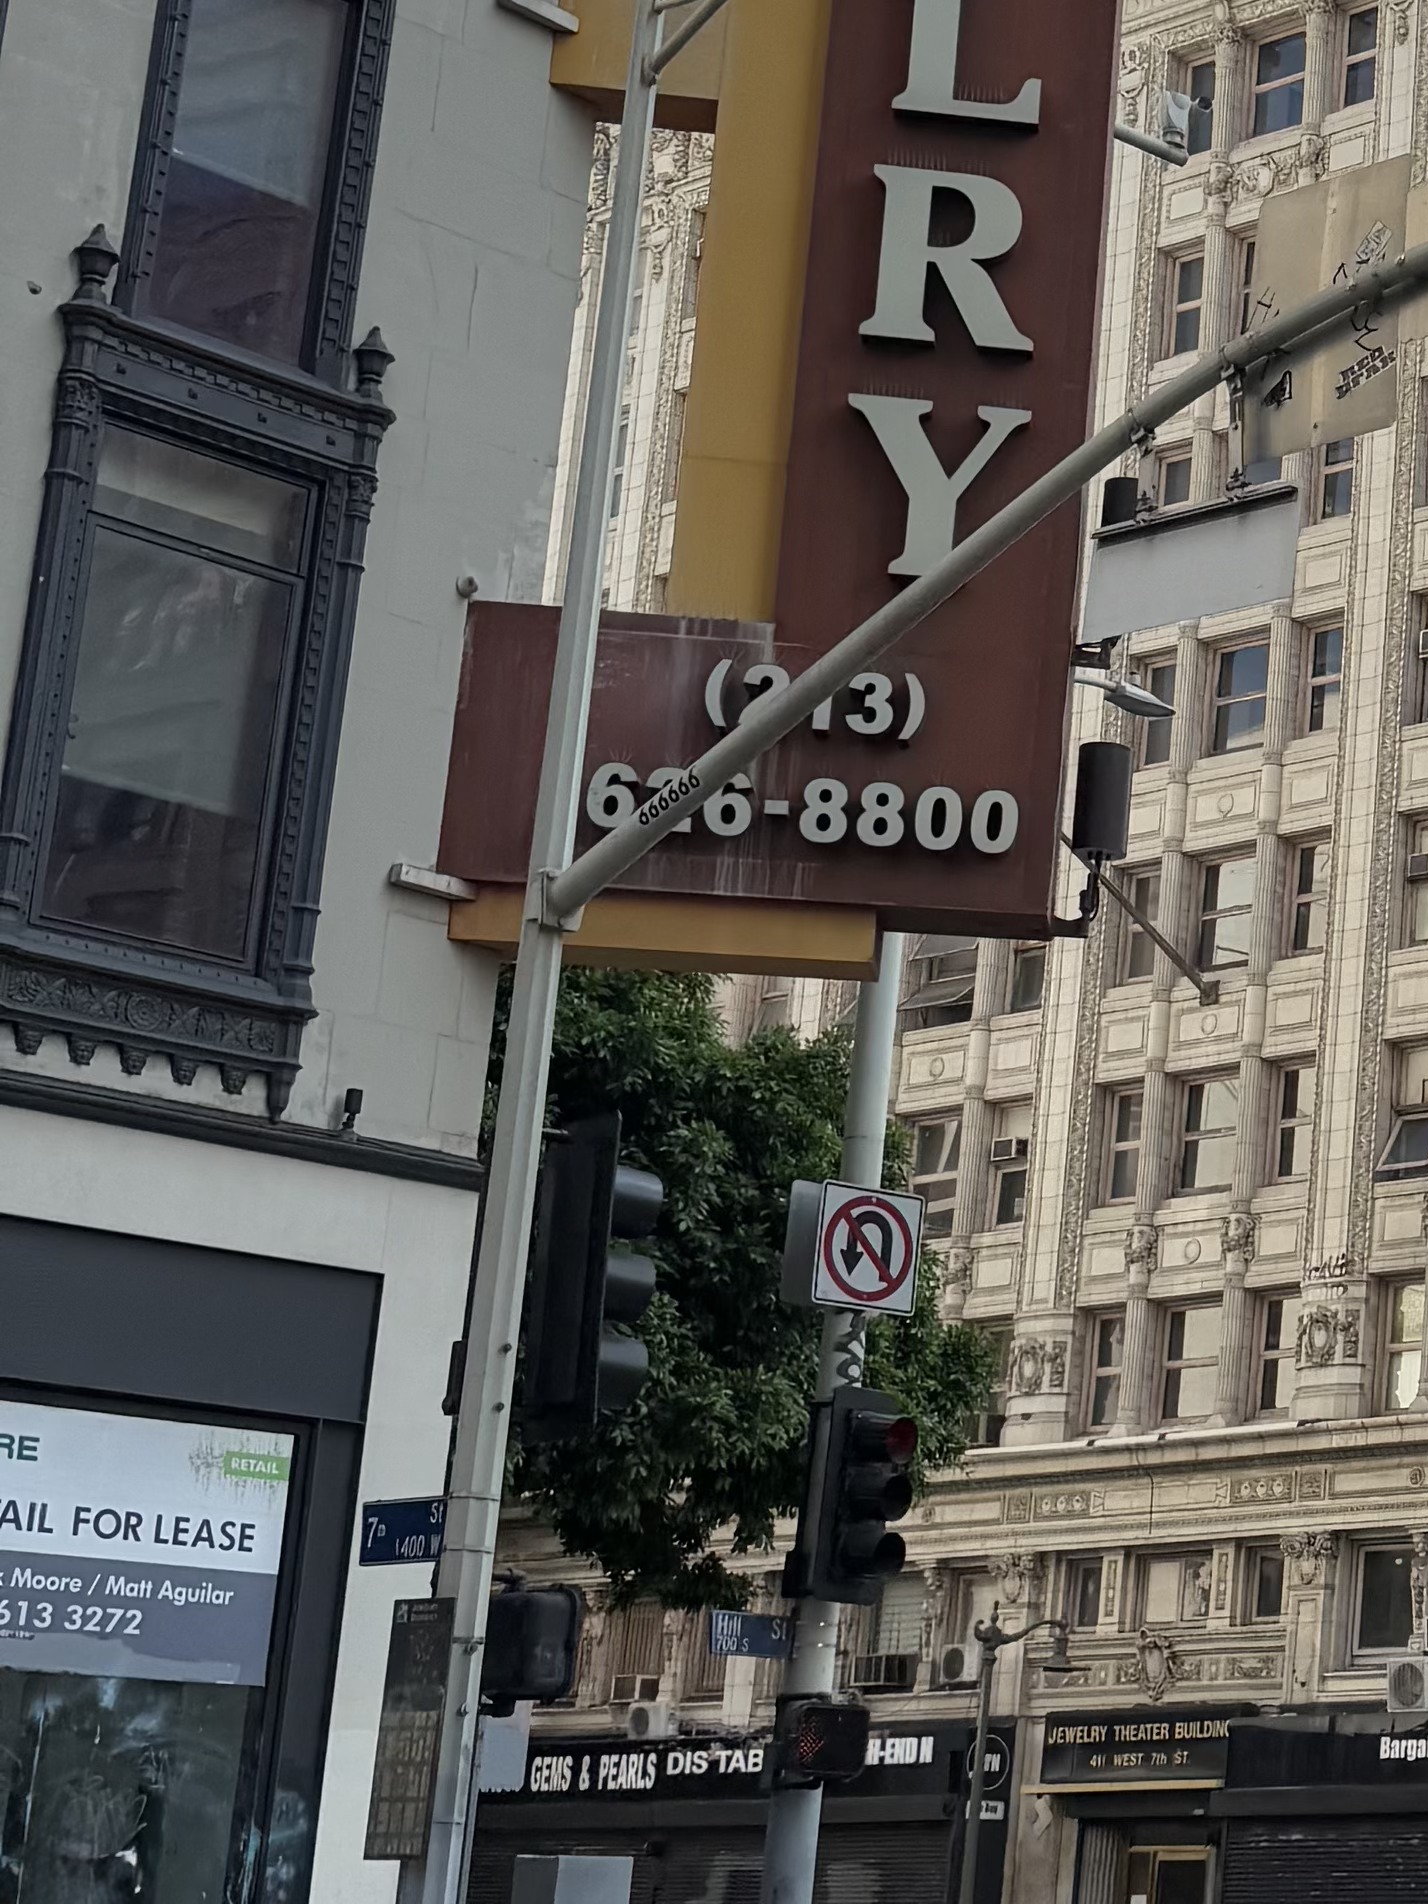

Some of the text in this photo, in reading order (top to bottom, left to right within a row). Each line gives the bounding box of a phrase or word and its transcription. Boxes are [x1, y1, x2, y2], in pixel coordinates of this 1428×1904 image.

[639, 765, 700, 826] 666666
[230, 1457, 279, 1475] RETAIL
[429, 1502, 443, 1524] St
[0, 1499, 256, 1553] AIL FOR LEASE
[10, 1567, 82, 1593] Moore
[105, 1575, 152, 1599] Matt
[157, 1579, 235, 1606] Aguilar
[0, 1599, 143, 1635] 613 3272
[716, 1612, 742, 1636] Hill
[716, 1636, 737, 1651] 700
[1049, 1725, 1108, 1744] JEWELRY
[1114, 1722, 1169, 1742] THEATER
[1113, 1752, 1144, 1767] WEST
[1150, 1751, 1167, 1766] 7th
[530, 1755, 573, 1792] GEMS
[578, 1755, 590, 1789] &
[598, 1753, 657, 1790] PEARLS
